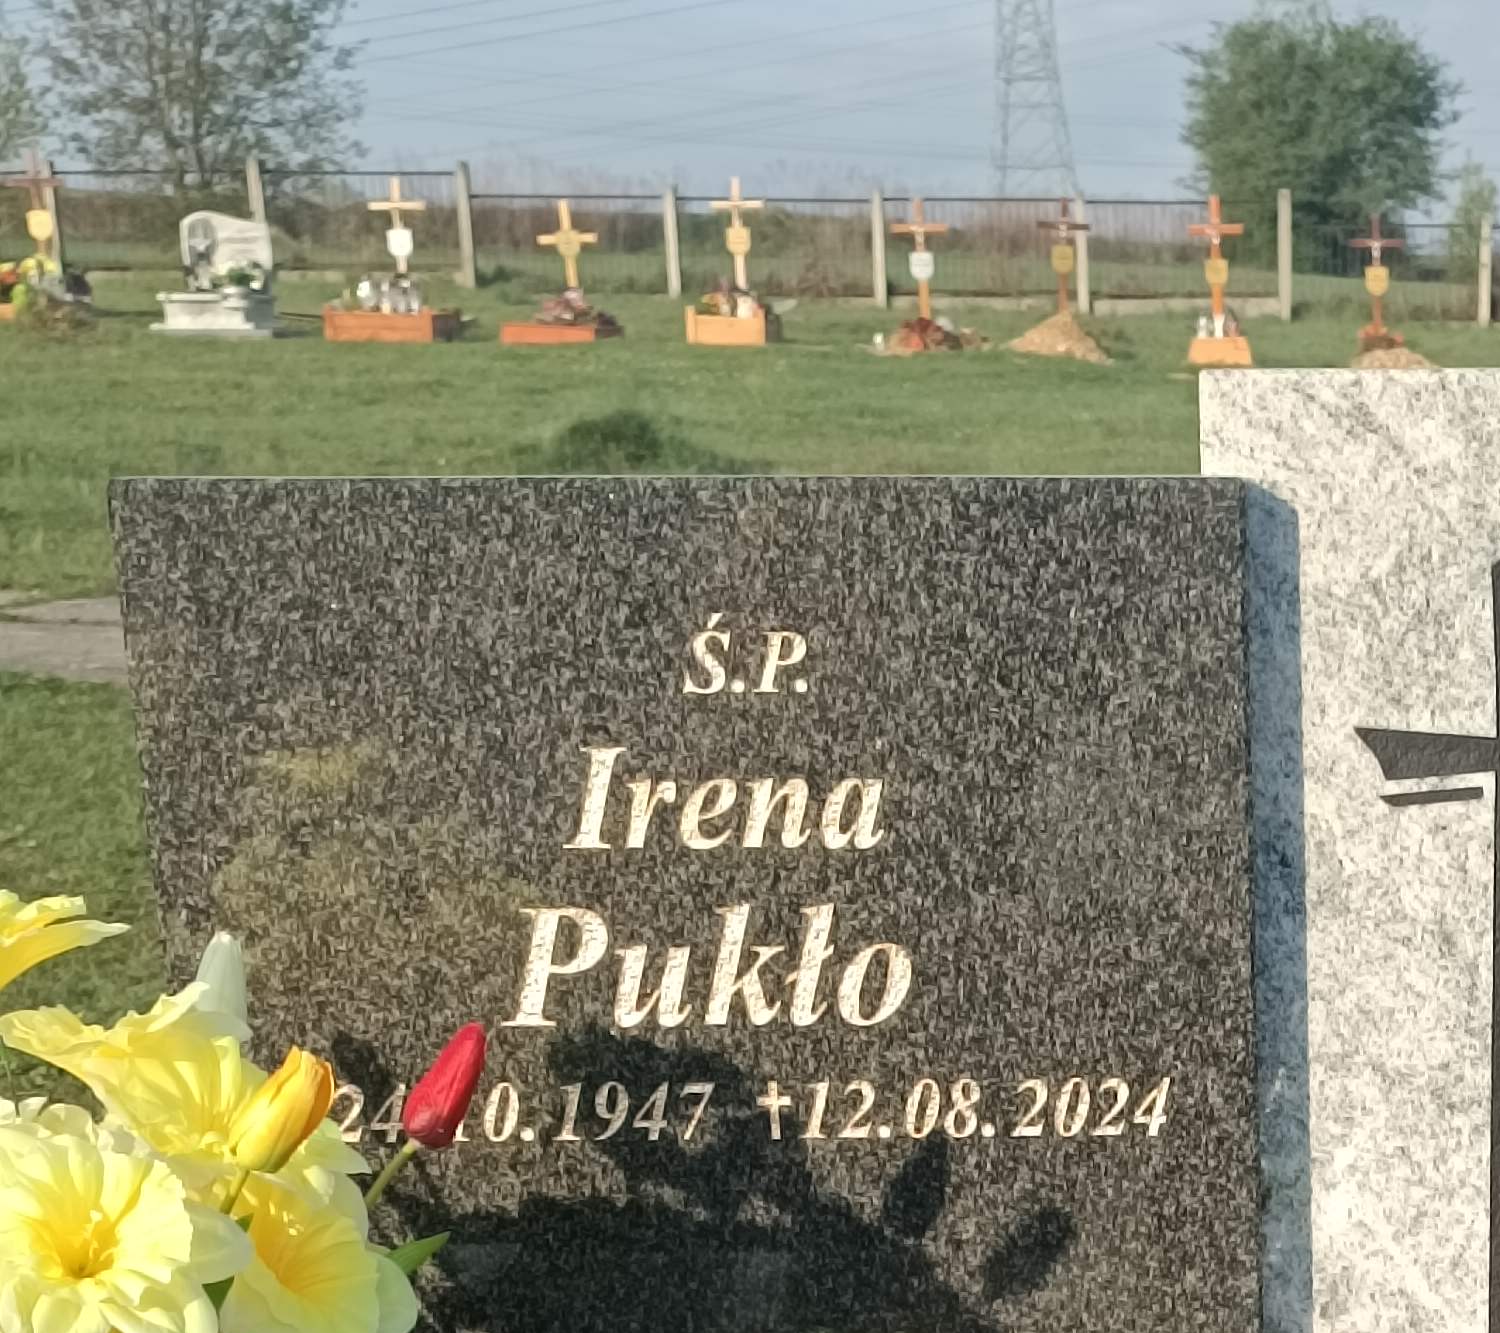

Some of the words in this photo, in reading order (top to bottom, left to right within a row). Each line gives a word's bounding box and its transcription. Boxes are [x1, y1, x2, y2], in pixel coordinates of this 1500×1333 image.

[682, 612, 810, 695] Ś.P.
[563, 745, 887, 851] Irena
[501, 902, 914, 1029] Pukło
[333, 1080, 717, 1143] 240.1947
